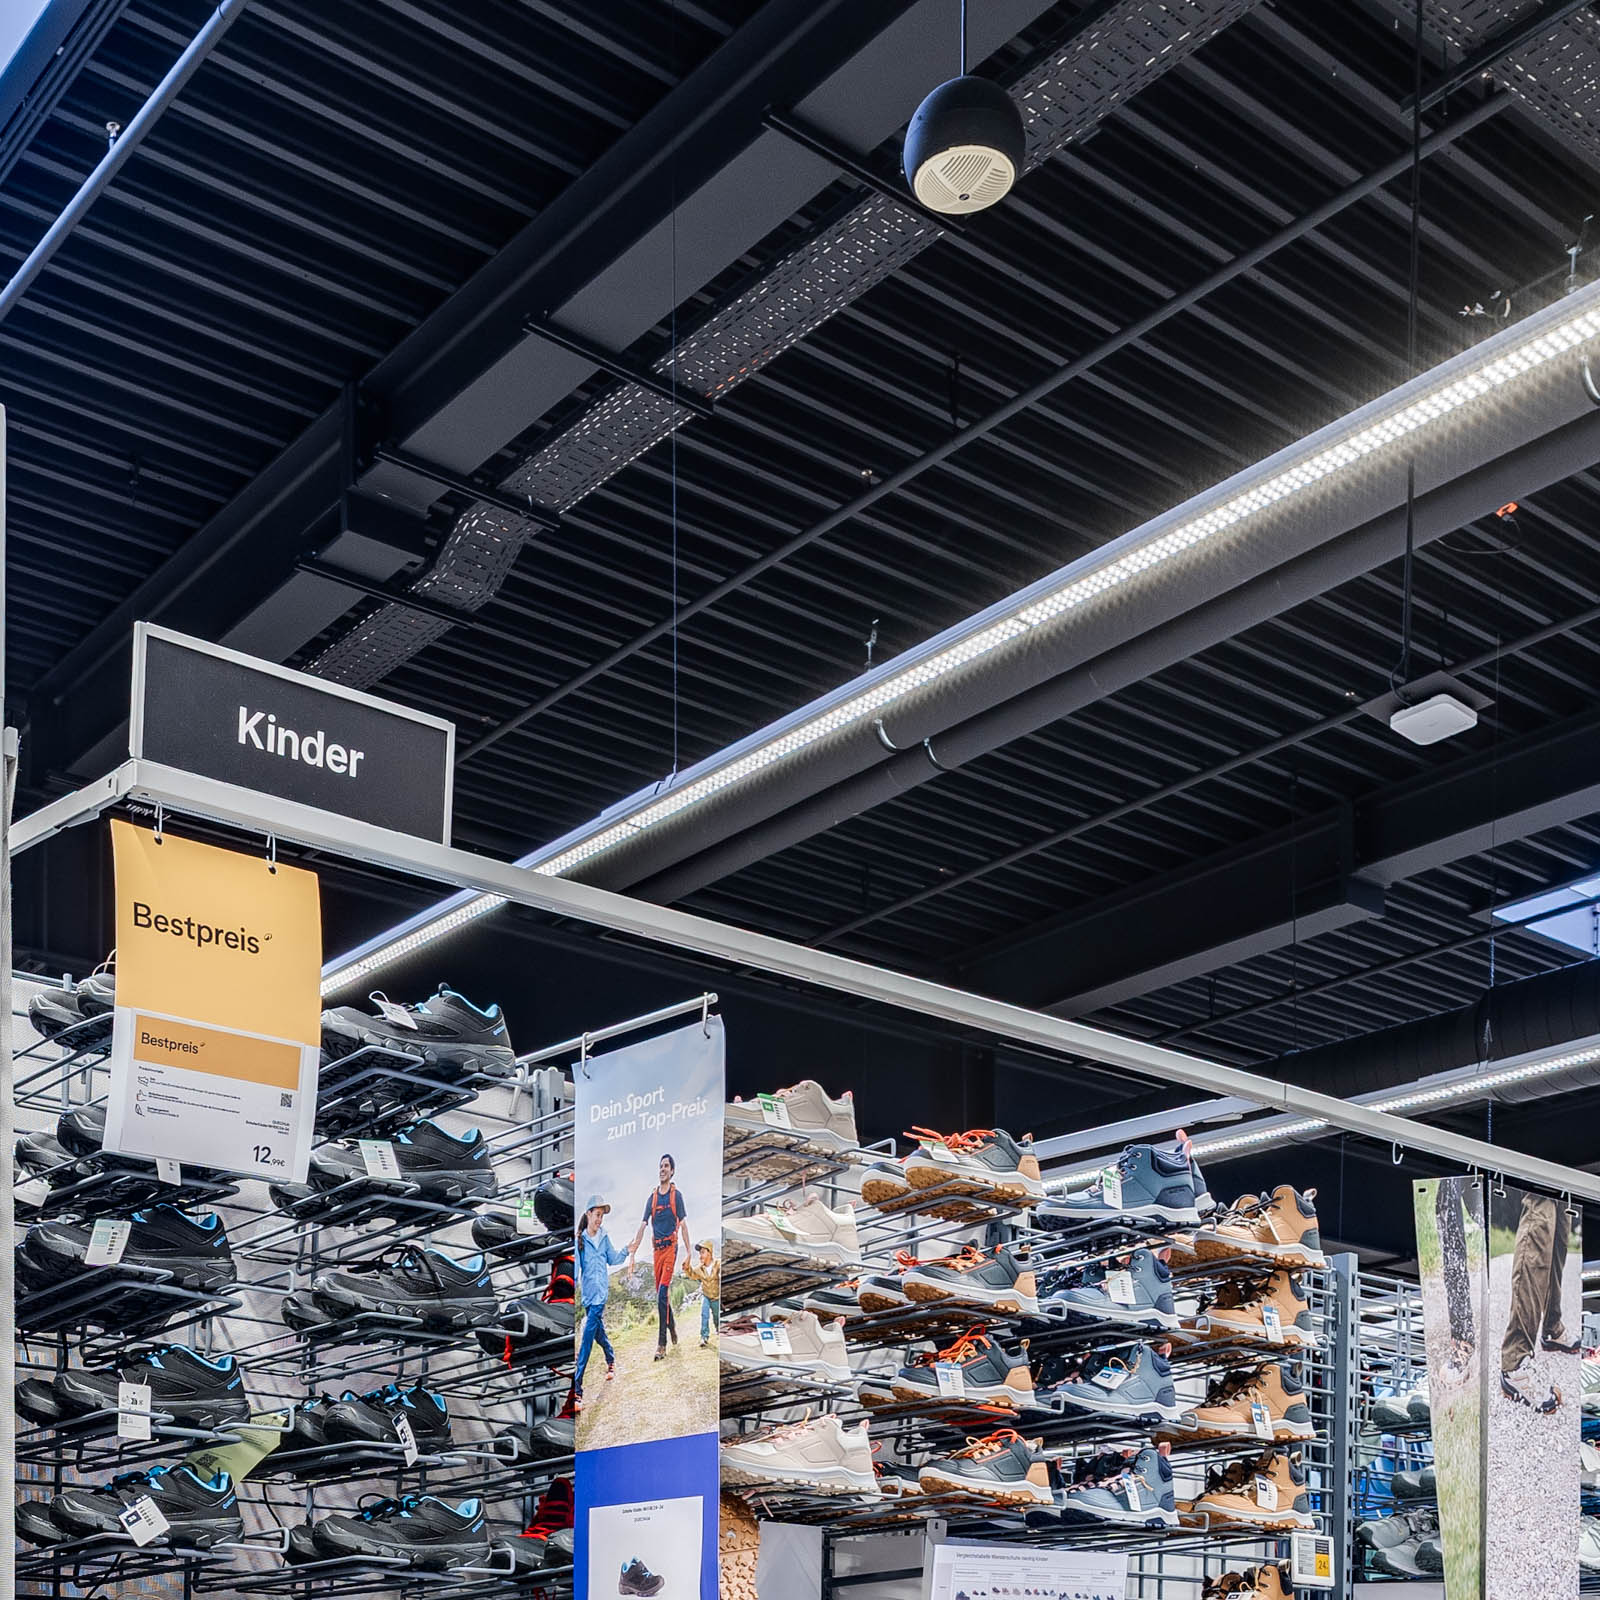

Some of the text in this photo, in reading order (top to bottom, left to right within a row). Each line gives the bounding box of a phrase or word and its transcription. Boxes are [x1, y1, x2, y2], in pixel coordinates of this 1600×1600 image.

[238, 706, 364, 778] Kinder
[133, 901, 260, 955] Bestpreis
[141, 1031, 199, 1055] Bestpreis
[590, 1085, 664, 1123] Dein Sport
[607, 1097, 707, 1140] zum Top-Preis
[253, 1145, 286, 1167] 12,99€
